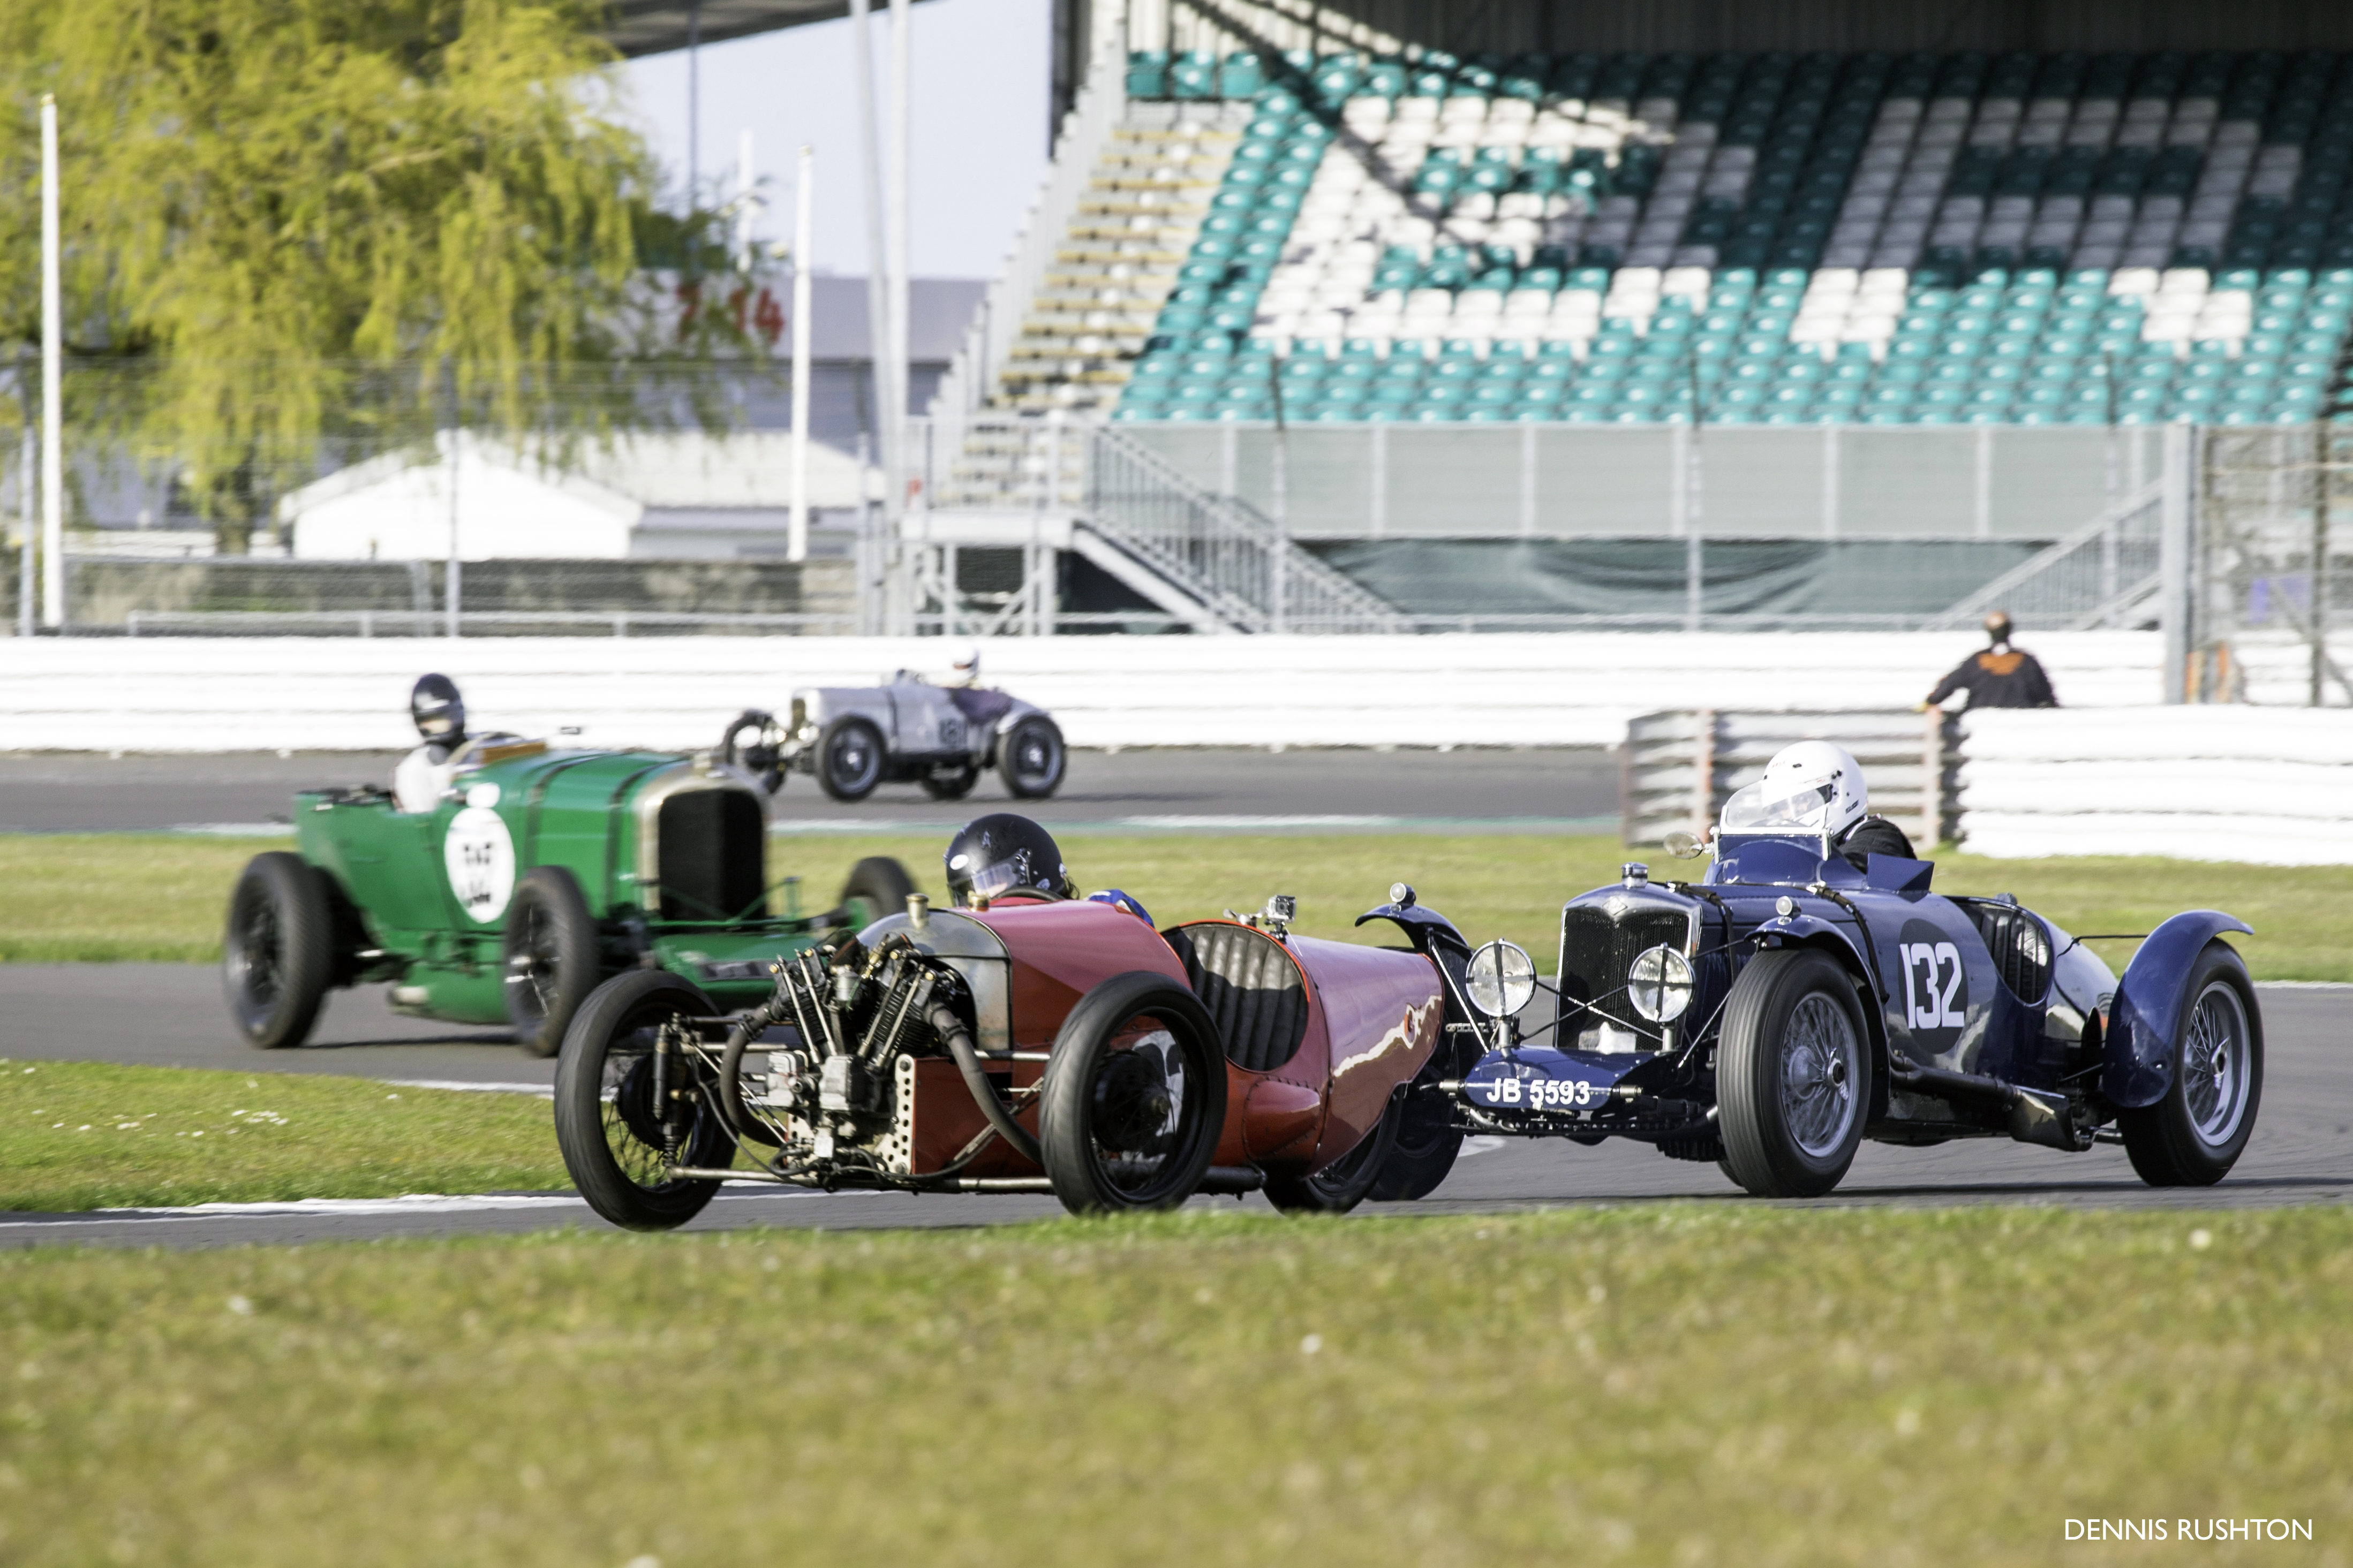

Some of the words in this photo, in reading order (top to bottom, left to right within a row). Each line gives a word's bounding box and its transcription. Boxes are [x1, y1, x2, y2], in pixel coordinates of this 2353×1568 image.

[1899, 942, 1965, 1029] 132
[1487, 1078, 1521, 1103] JB
[1529, 1079, 1590, 1105] 5593
